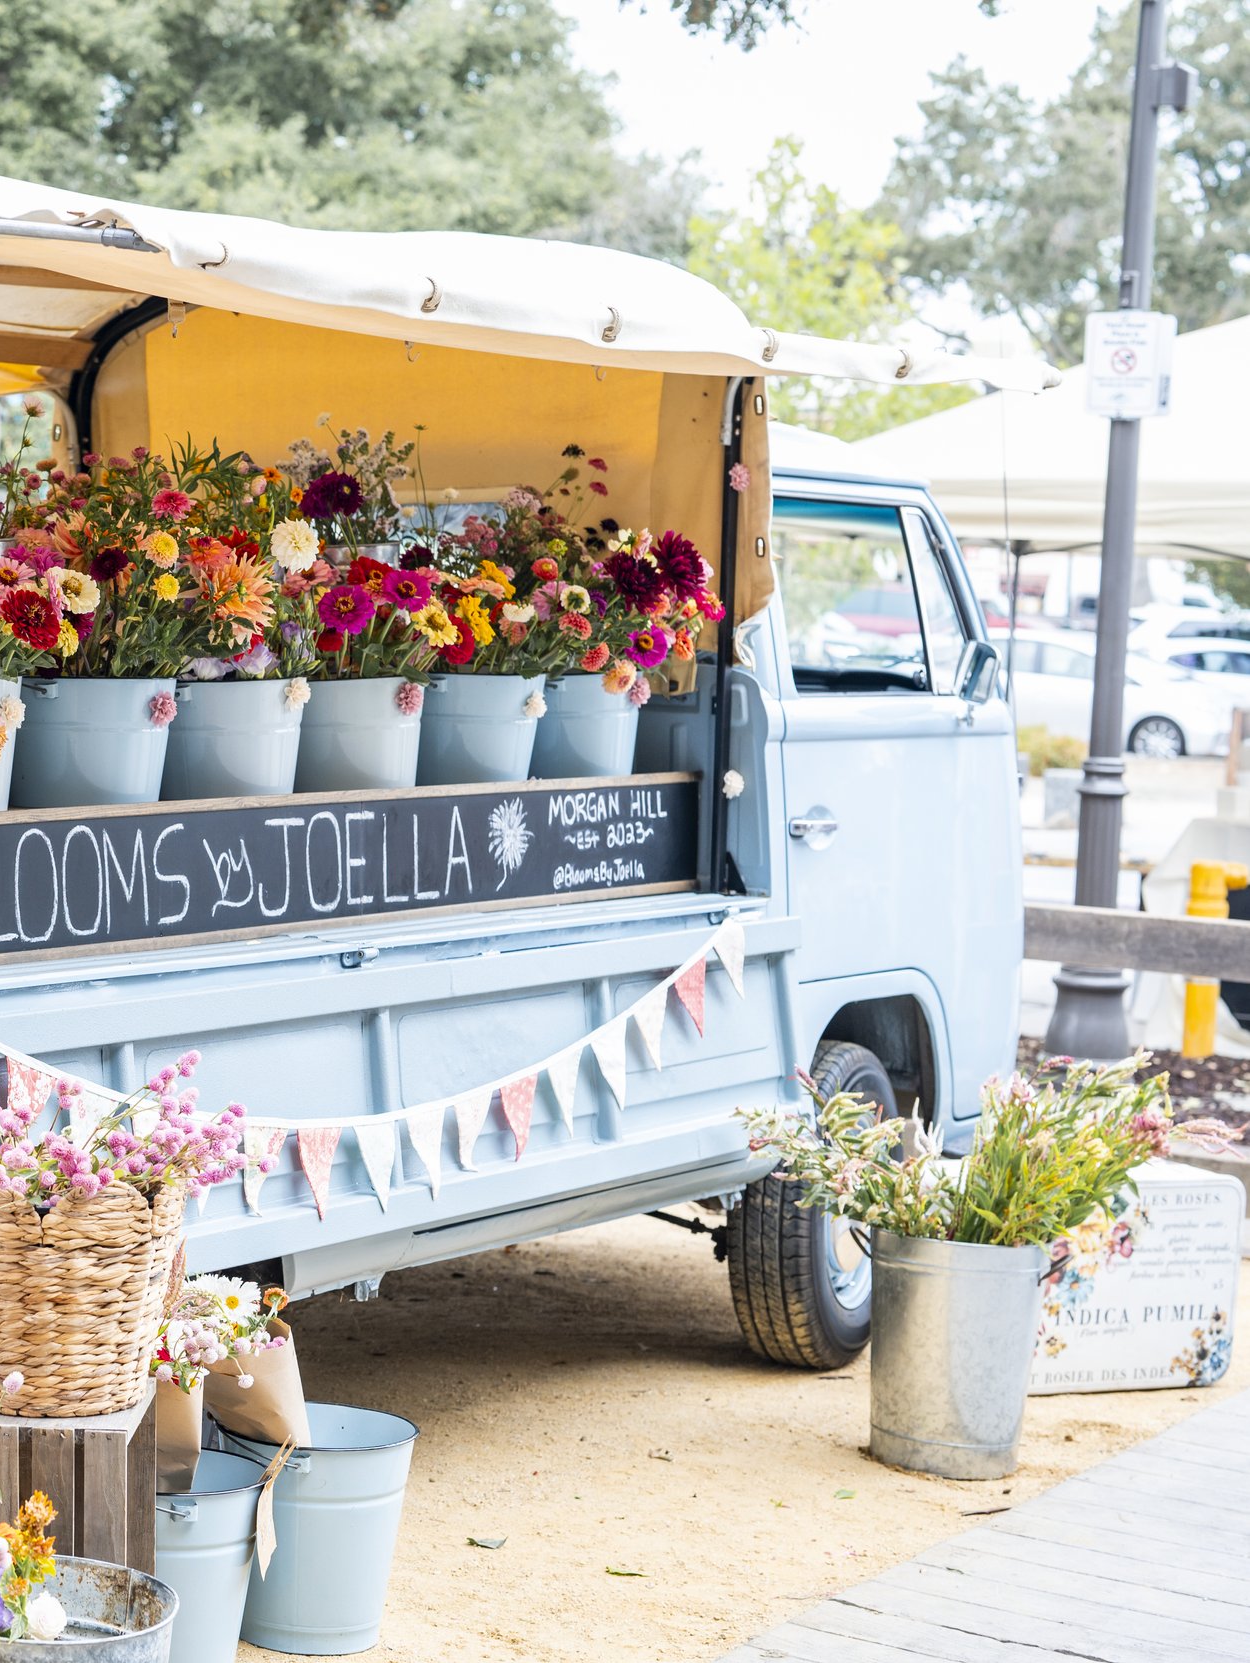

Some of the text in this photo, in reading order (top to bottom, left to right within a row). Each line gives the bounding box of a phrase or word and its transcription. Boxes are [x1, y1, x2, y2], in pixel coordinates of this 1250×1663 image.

[548, 790, 668, 826] MORGAN HILL
[202, 838, 254, 917] by
[258, 806, 473, 917] JOELLA
[553, 858, 645, 890] @BloomsByJoella
[1054, 1306, 1130, 1327] INDICA
[1045, 1370, 1094, 1385] ROSIER
[1101, 1367, 1128, 1382] DES
